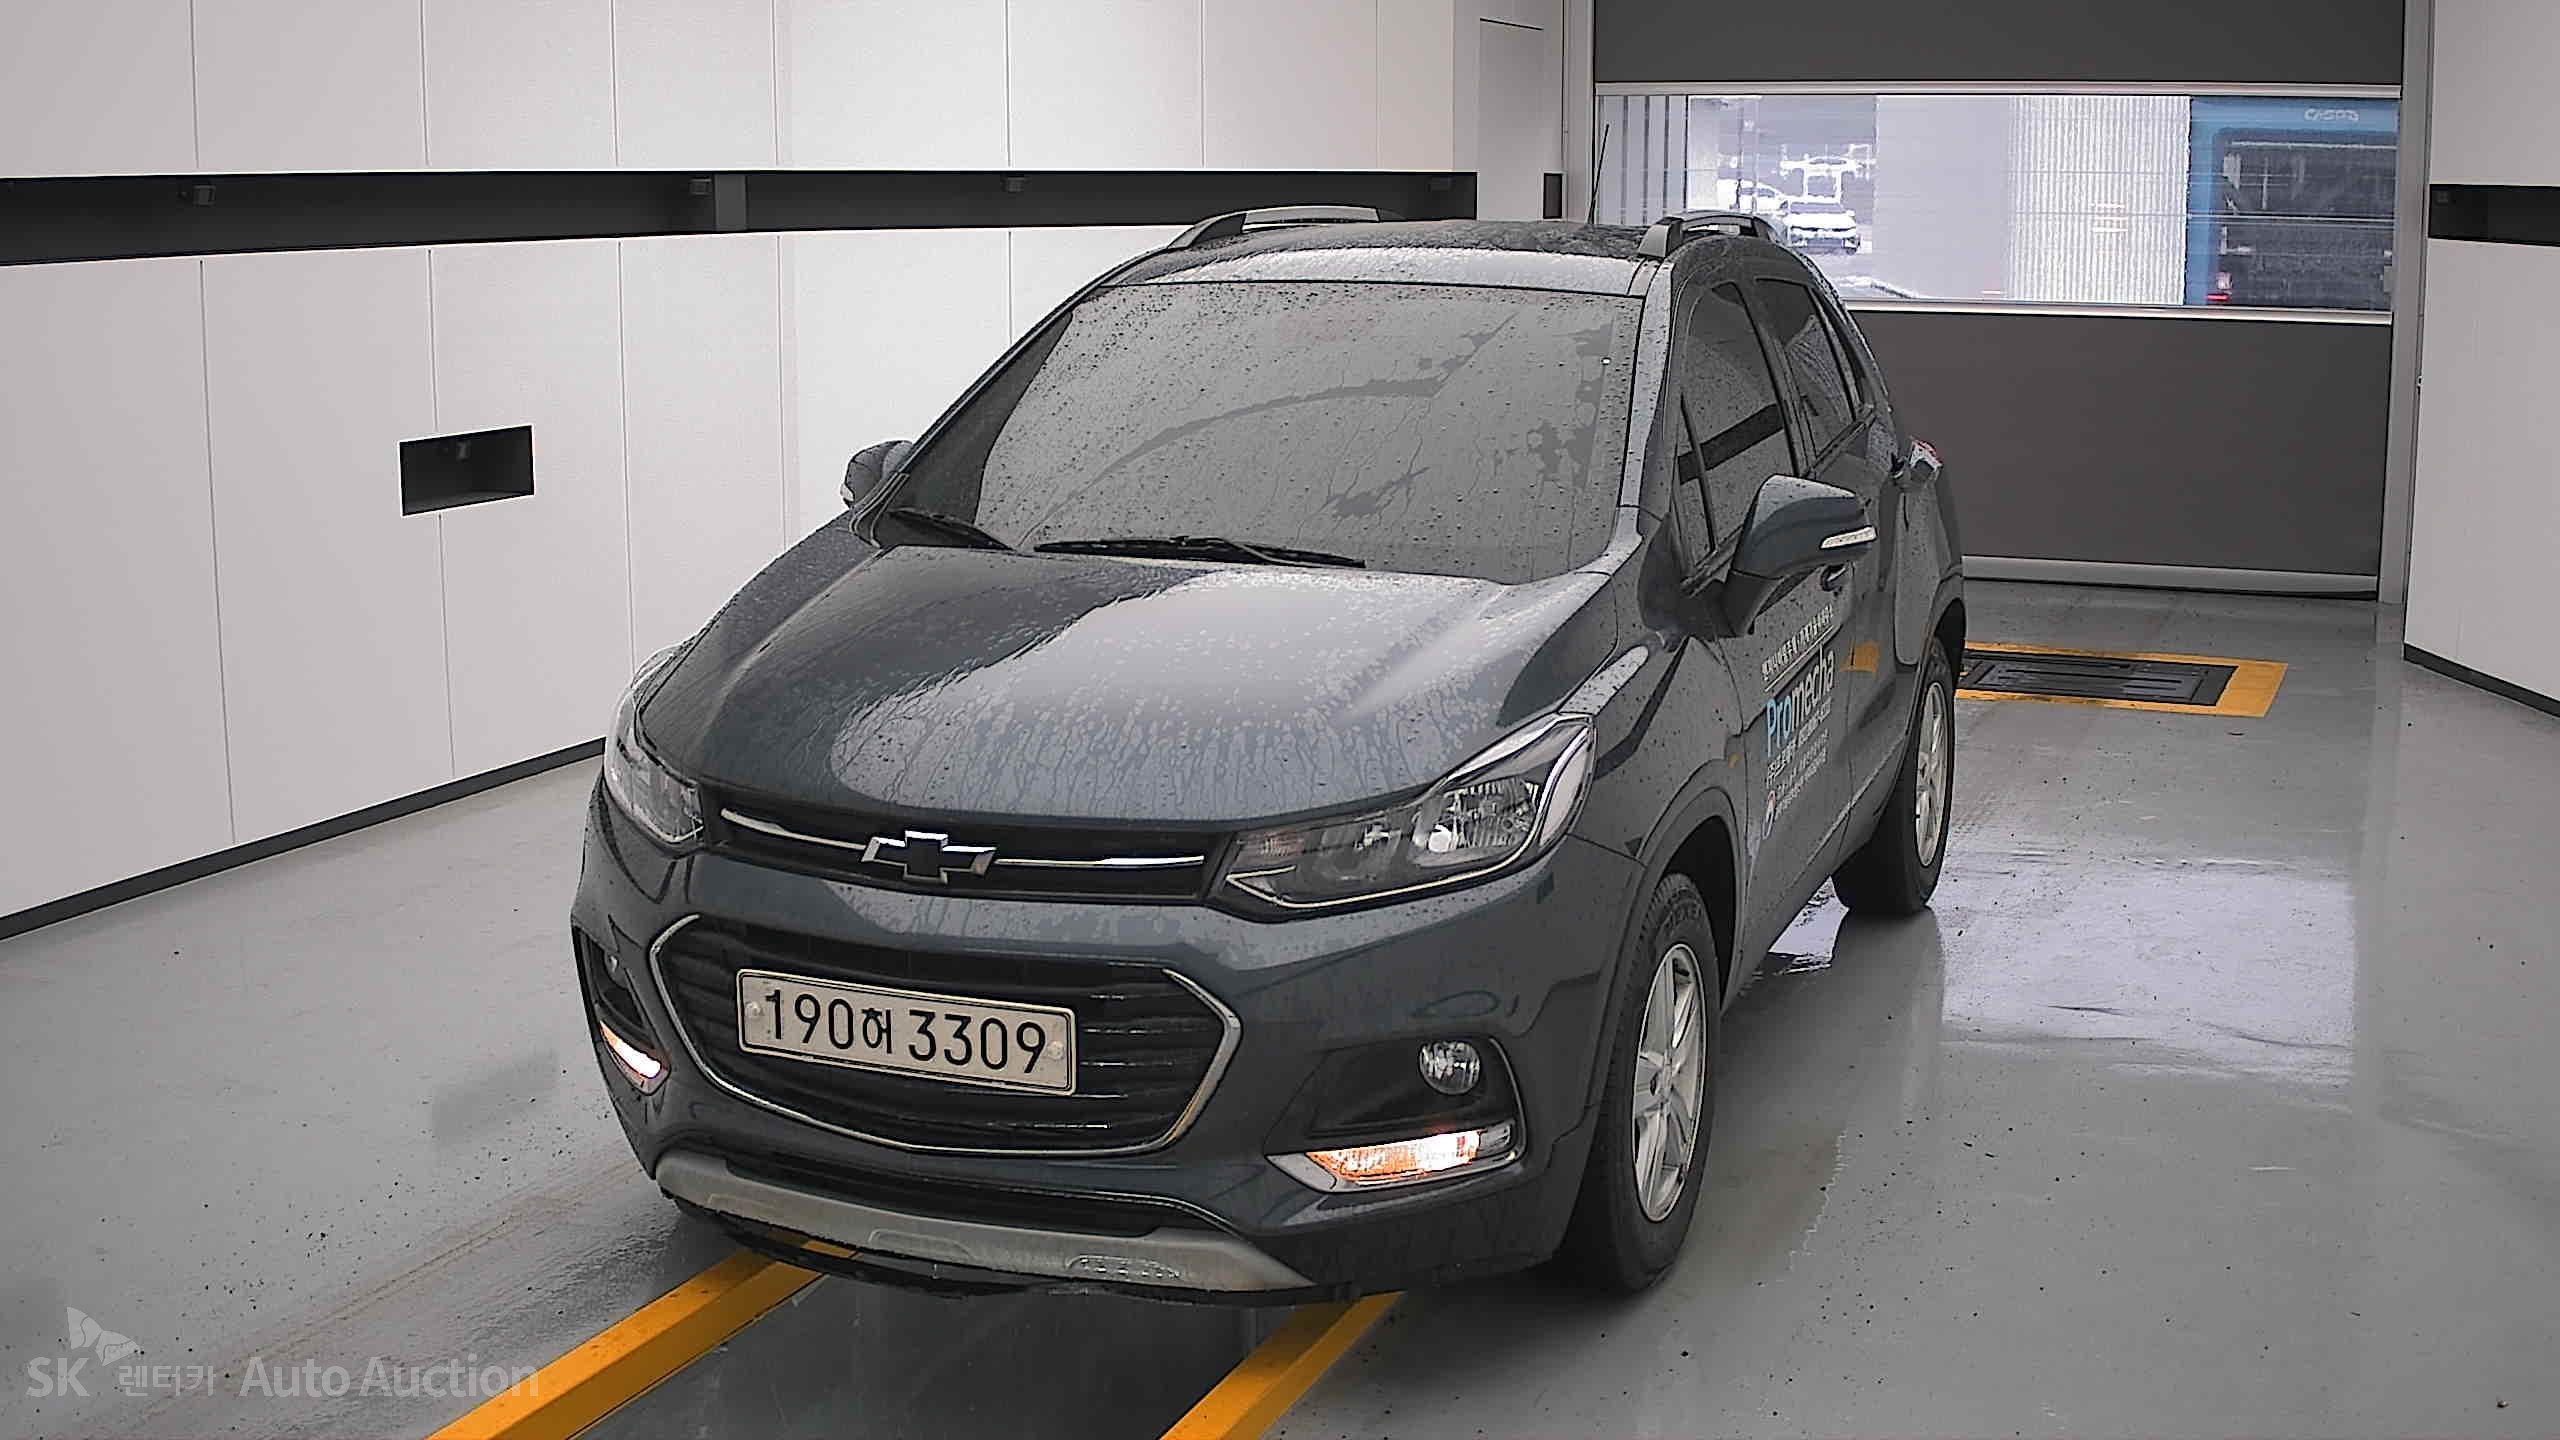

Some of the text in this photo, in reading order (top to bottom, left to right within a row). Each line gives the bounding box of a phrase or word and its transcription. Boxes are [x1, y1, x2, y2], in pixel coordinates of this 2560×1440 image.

[1766, 644, 1835, 758] Promecha
[764, 988, 1047, 1074] 190허 3309
